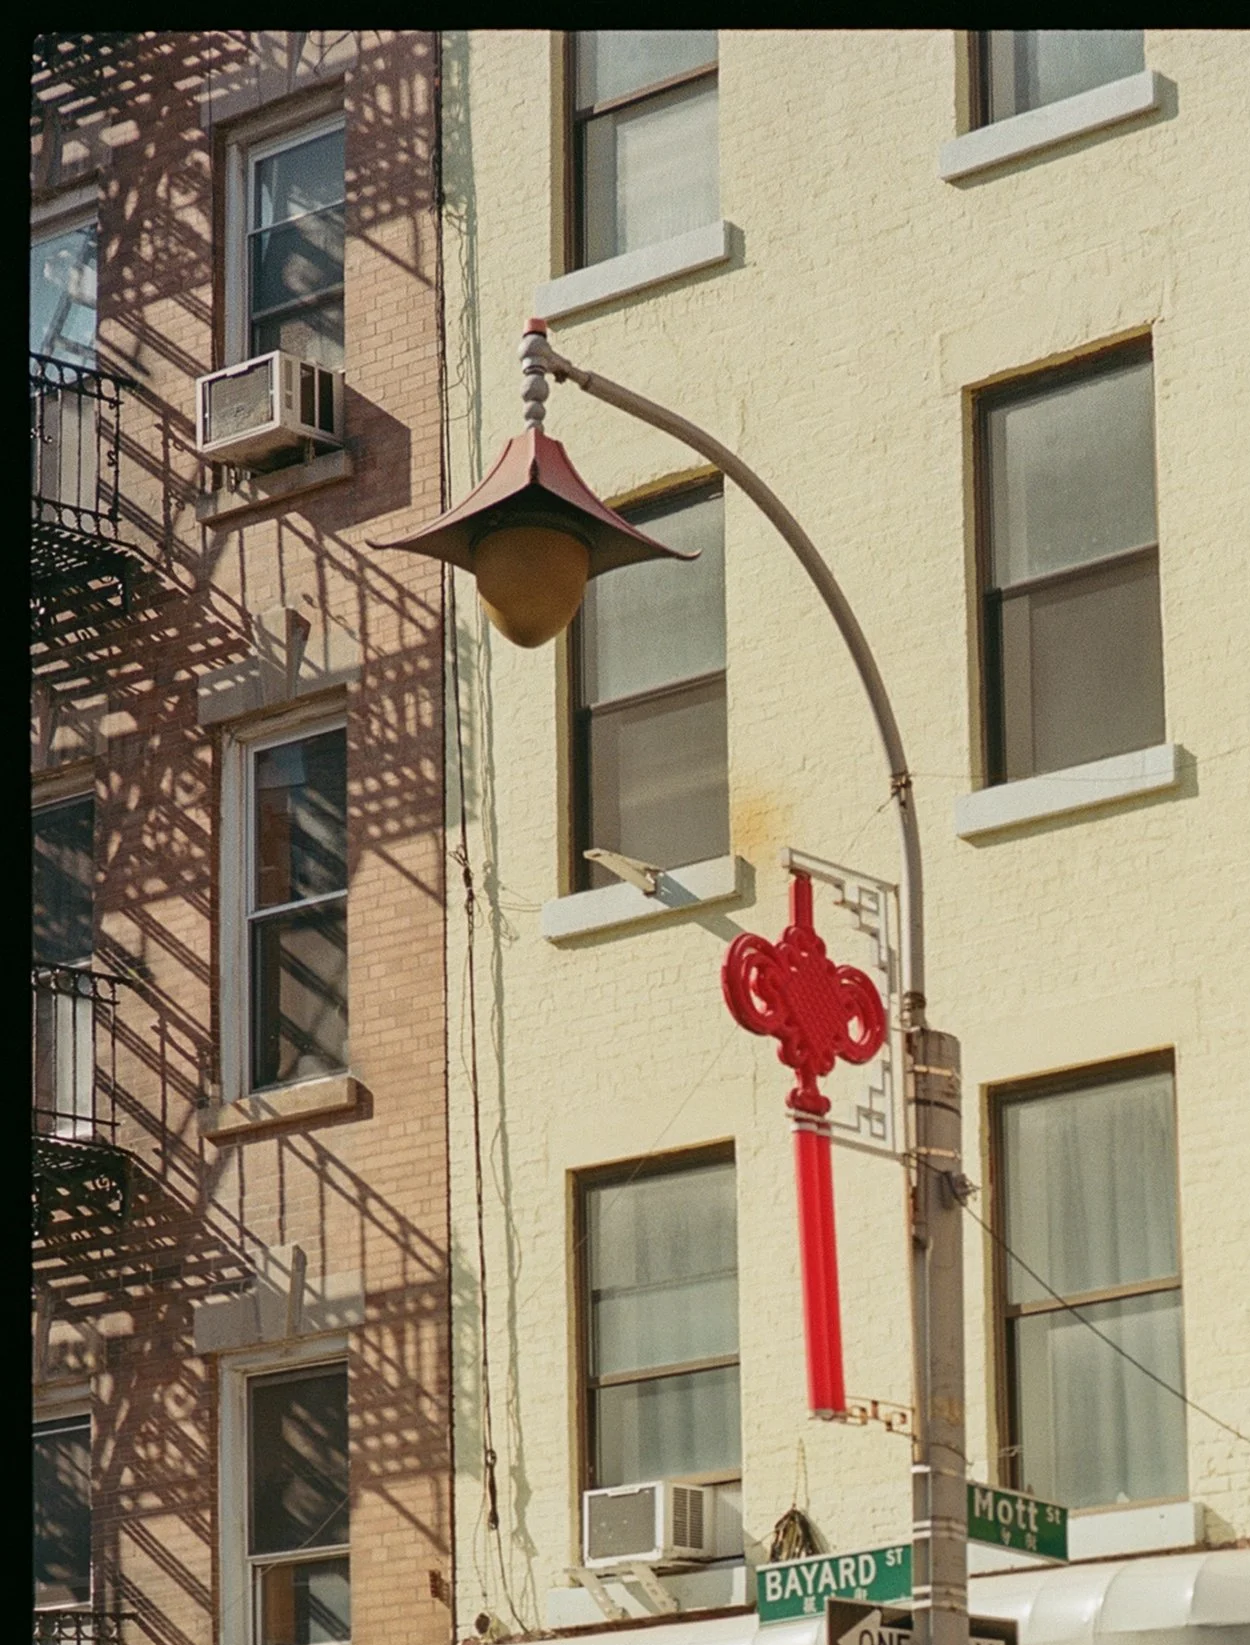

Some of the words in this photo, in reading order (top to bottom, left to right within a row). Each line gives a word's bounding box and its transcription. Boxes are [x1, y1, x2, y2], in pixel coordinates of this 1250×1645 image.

[973, 1487, 1039, 1533] Mott
[1044, 1507, 1061, 1525] St
[765, 1554, 877, 1602] BAYARD
[885, 1547, 904, 1567] ST
